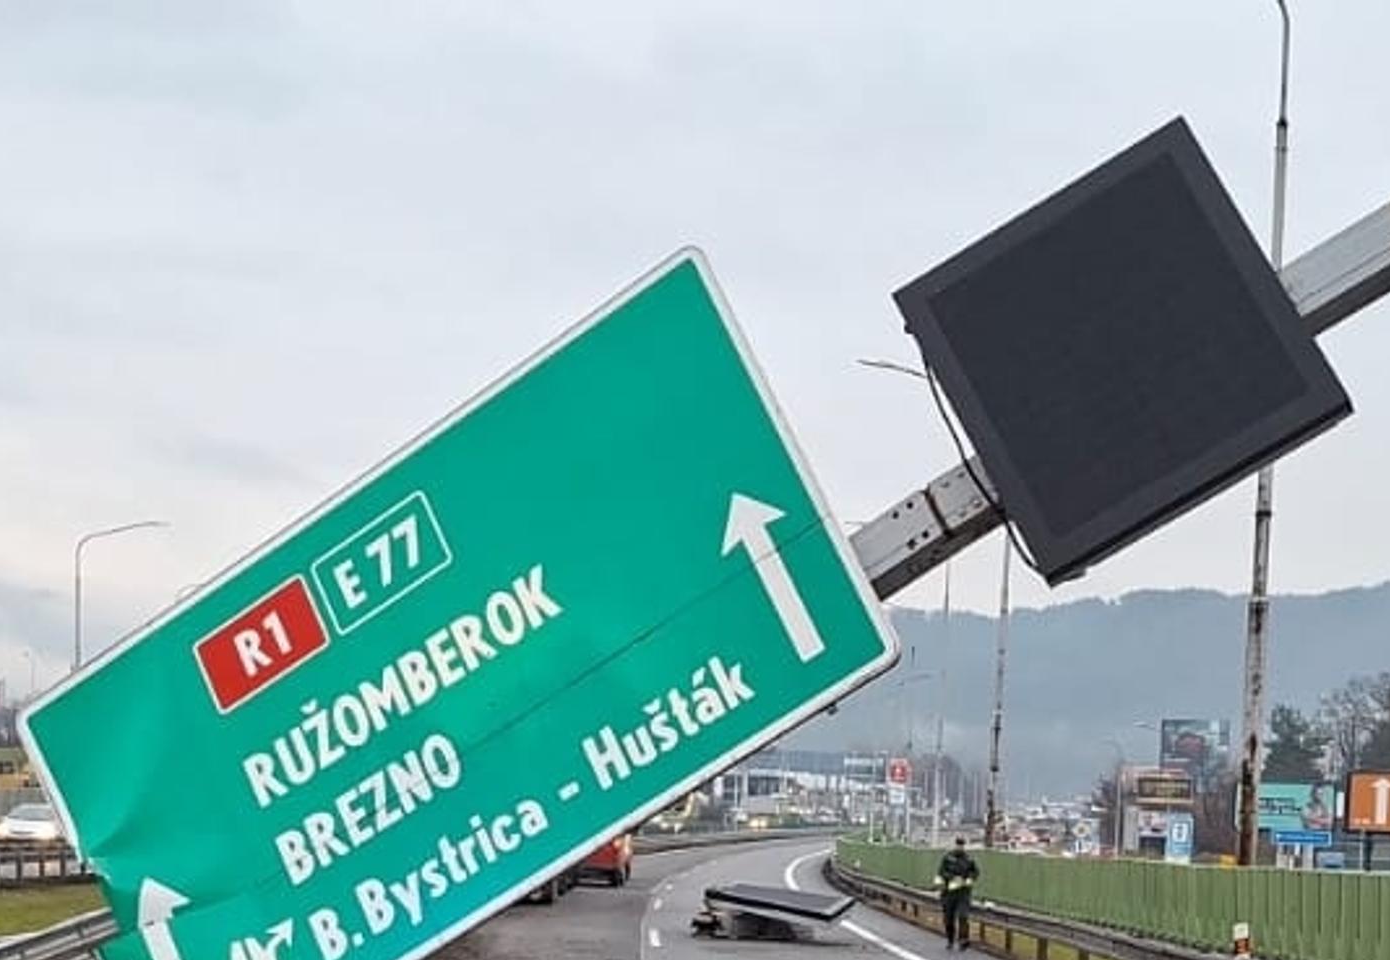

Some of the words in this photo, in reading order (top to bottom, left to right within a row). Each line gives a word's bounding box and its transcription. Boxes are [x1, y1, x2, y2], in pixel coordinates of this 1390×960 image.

[332, 558, 367, 609] E
[364, 514, 420, 588] 77
[233, 609, 293, 678] R1
[243, 564, 562, 808] RUŽOMBEROK
[581, 655, 756, 790] Hušták
[275, 734, 462, 886] BREZNO
